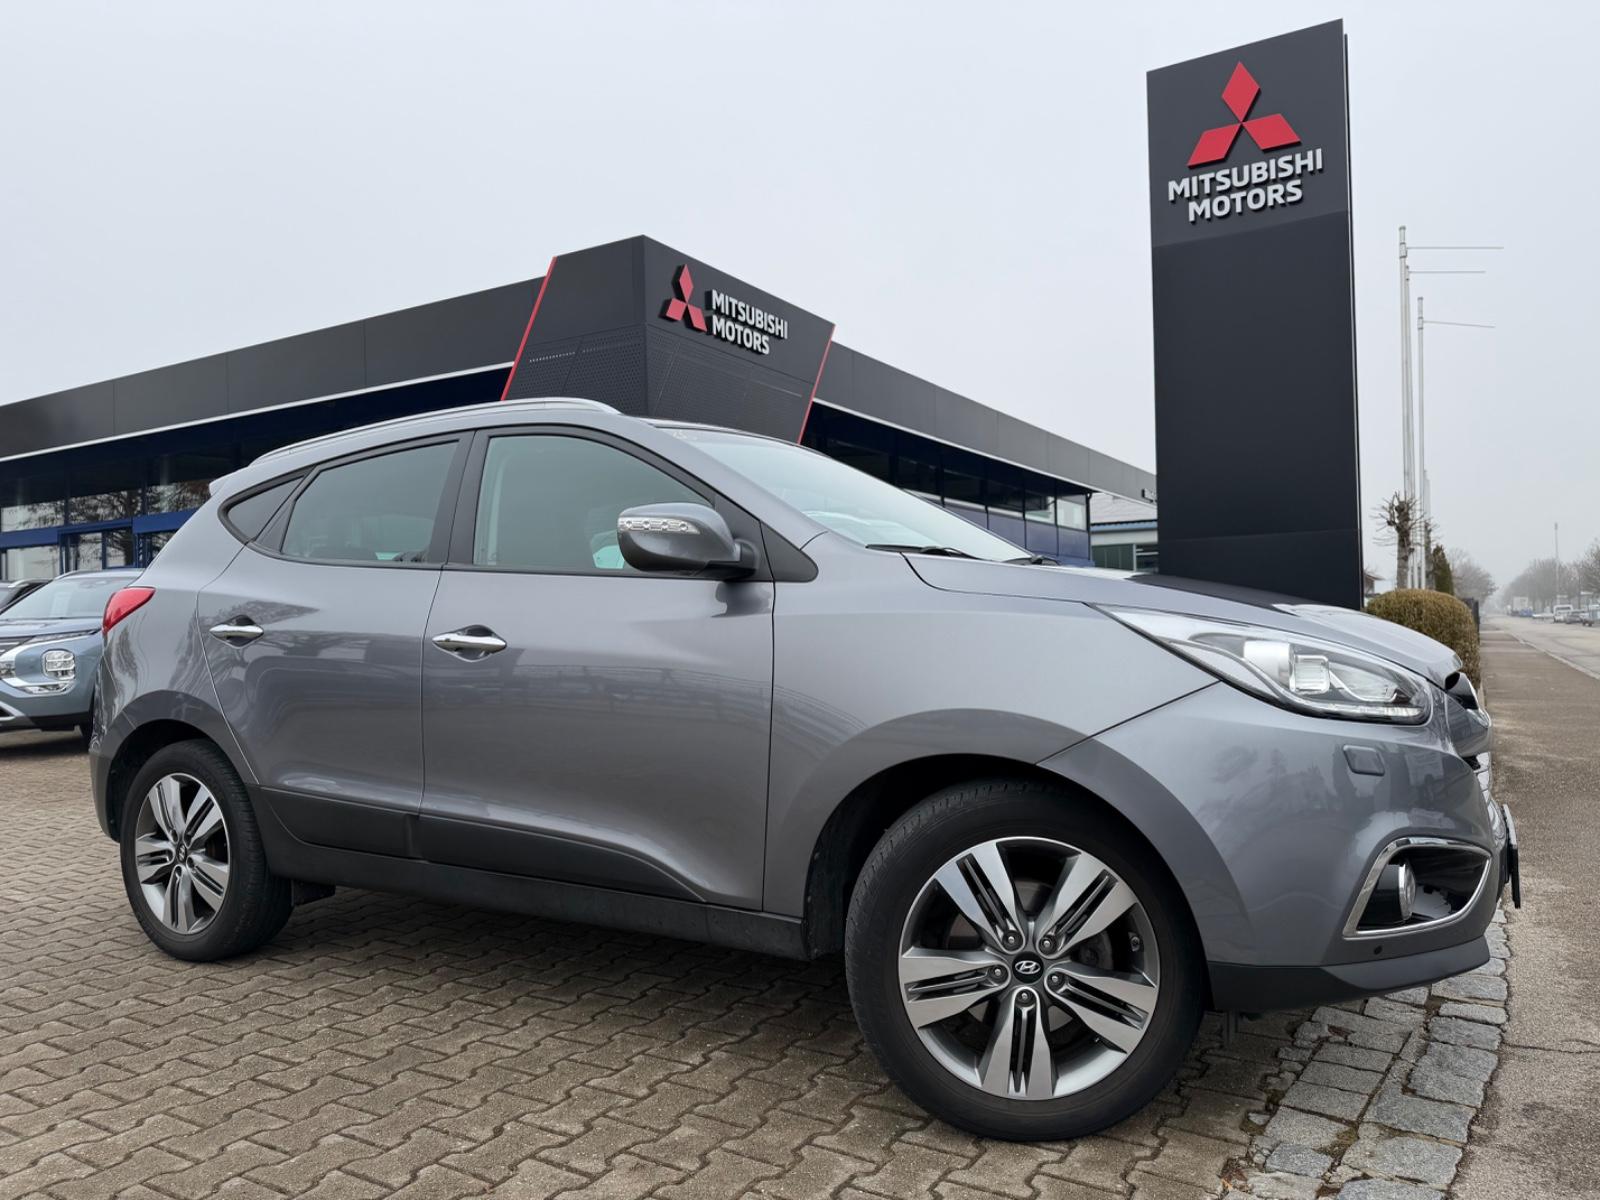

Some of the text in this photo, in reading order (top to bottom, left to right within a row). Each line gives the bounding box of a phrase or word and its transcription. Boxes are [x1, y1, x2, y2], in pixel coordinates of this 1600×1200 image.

[1168, 148, 1323, 201] MITSUBISHI
[1188, 179, 1303, 222] MOTORS
[711, 289, 788, 339] MITSUBISHI
[712, 314, 770, 355] MOTORS
